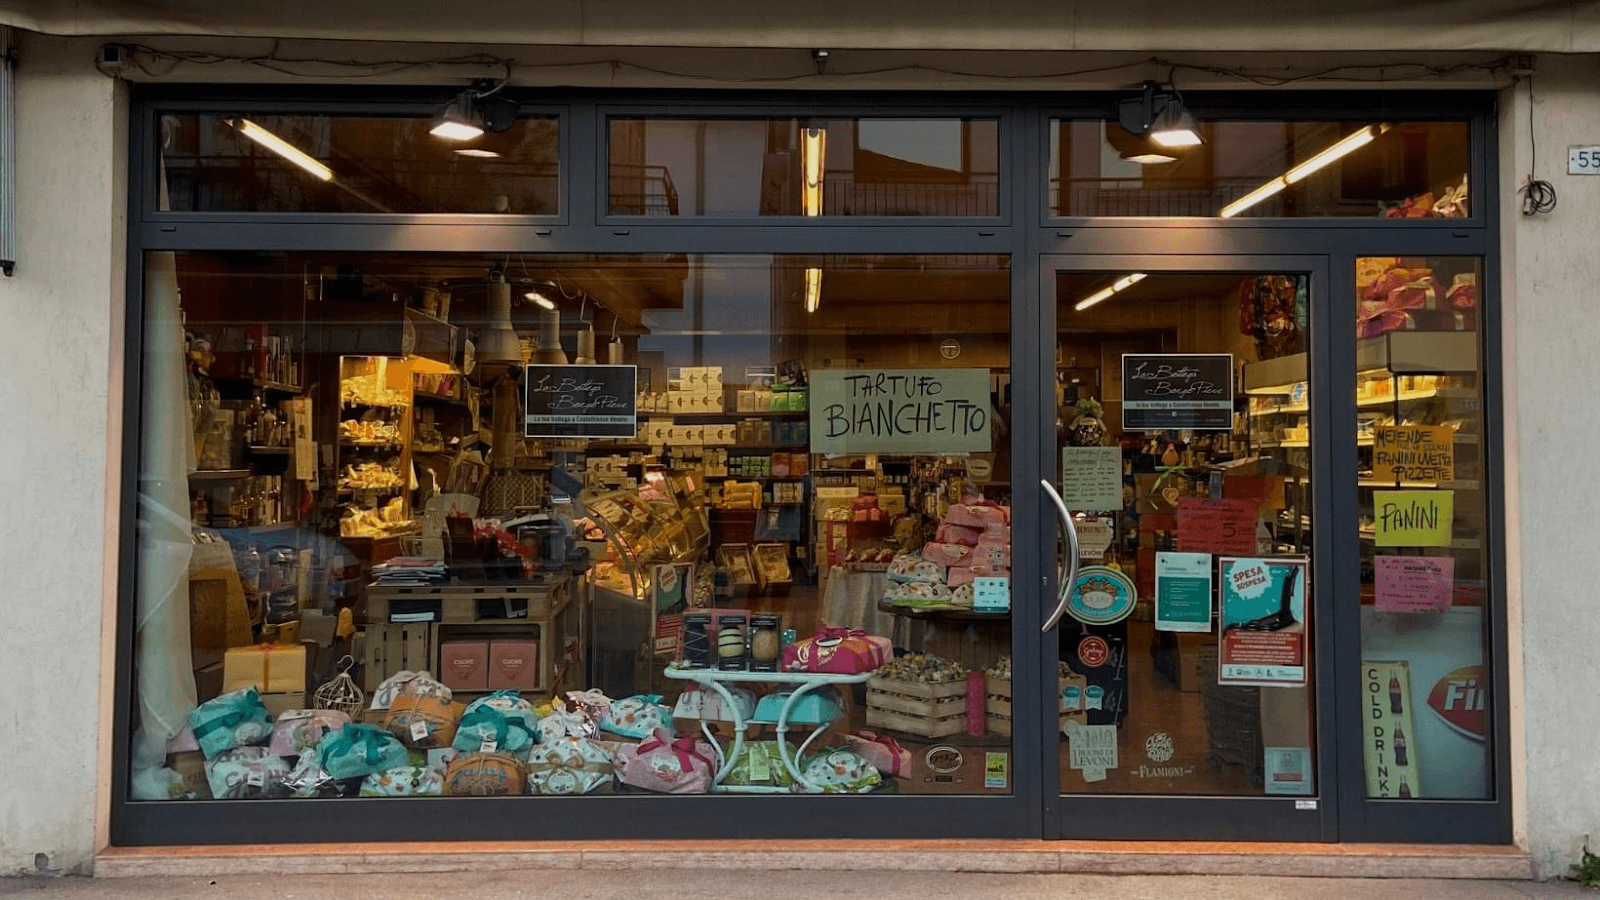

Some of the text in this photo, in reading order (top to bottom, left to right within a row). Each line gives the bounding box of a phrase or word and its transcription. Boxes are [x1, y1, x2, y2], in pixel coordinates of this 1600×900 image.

[843, 372, 943, 399] TARTUFO
[822, 399, 986, 438] BIANCHETTO
[1375, 450, 1415, 466] PANINI
[1391, 466, 1451, 482] PIZZETTE
[1380, 500, 1438, 533] PANINI
[1233, 566, 1264, 582] SPESA
[1236, 576, 1267, 591] SOSPESA
[1368, 669, 1382, 720] COLD
[1073, 756, 1114, 766] LEVONI
[1139, 765, 1184, 778] FLAMIGNI
